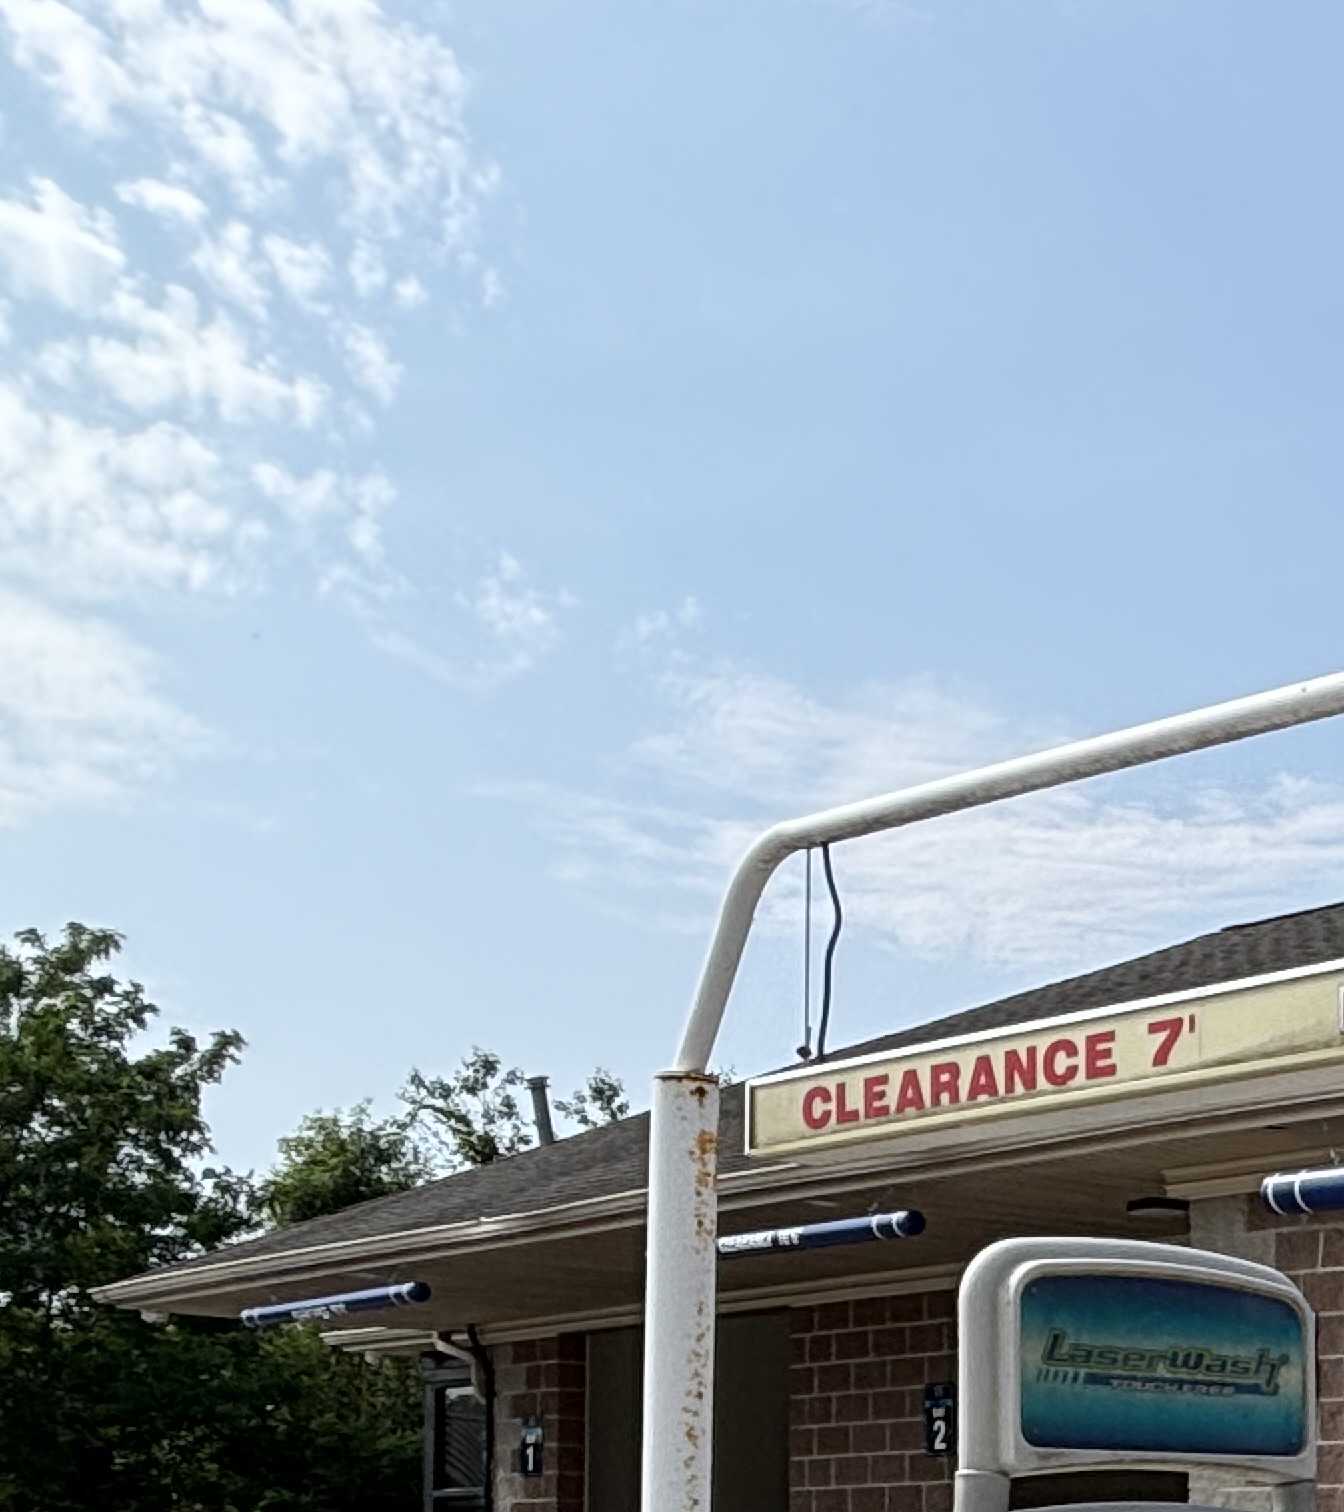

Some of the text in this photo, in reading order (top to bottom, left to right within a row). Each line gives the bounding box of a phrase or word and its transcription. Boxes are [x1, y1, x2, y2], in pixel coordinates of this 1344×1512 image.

[802, 1014, 1196, 1130] CLEARANCE 7'
[1041, 1327, 1281, 1395] LaserWash
[526, 1445, 534, 1471] 1
[932, 1420, 948, 1449] 2
